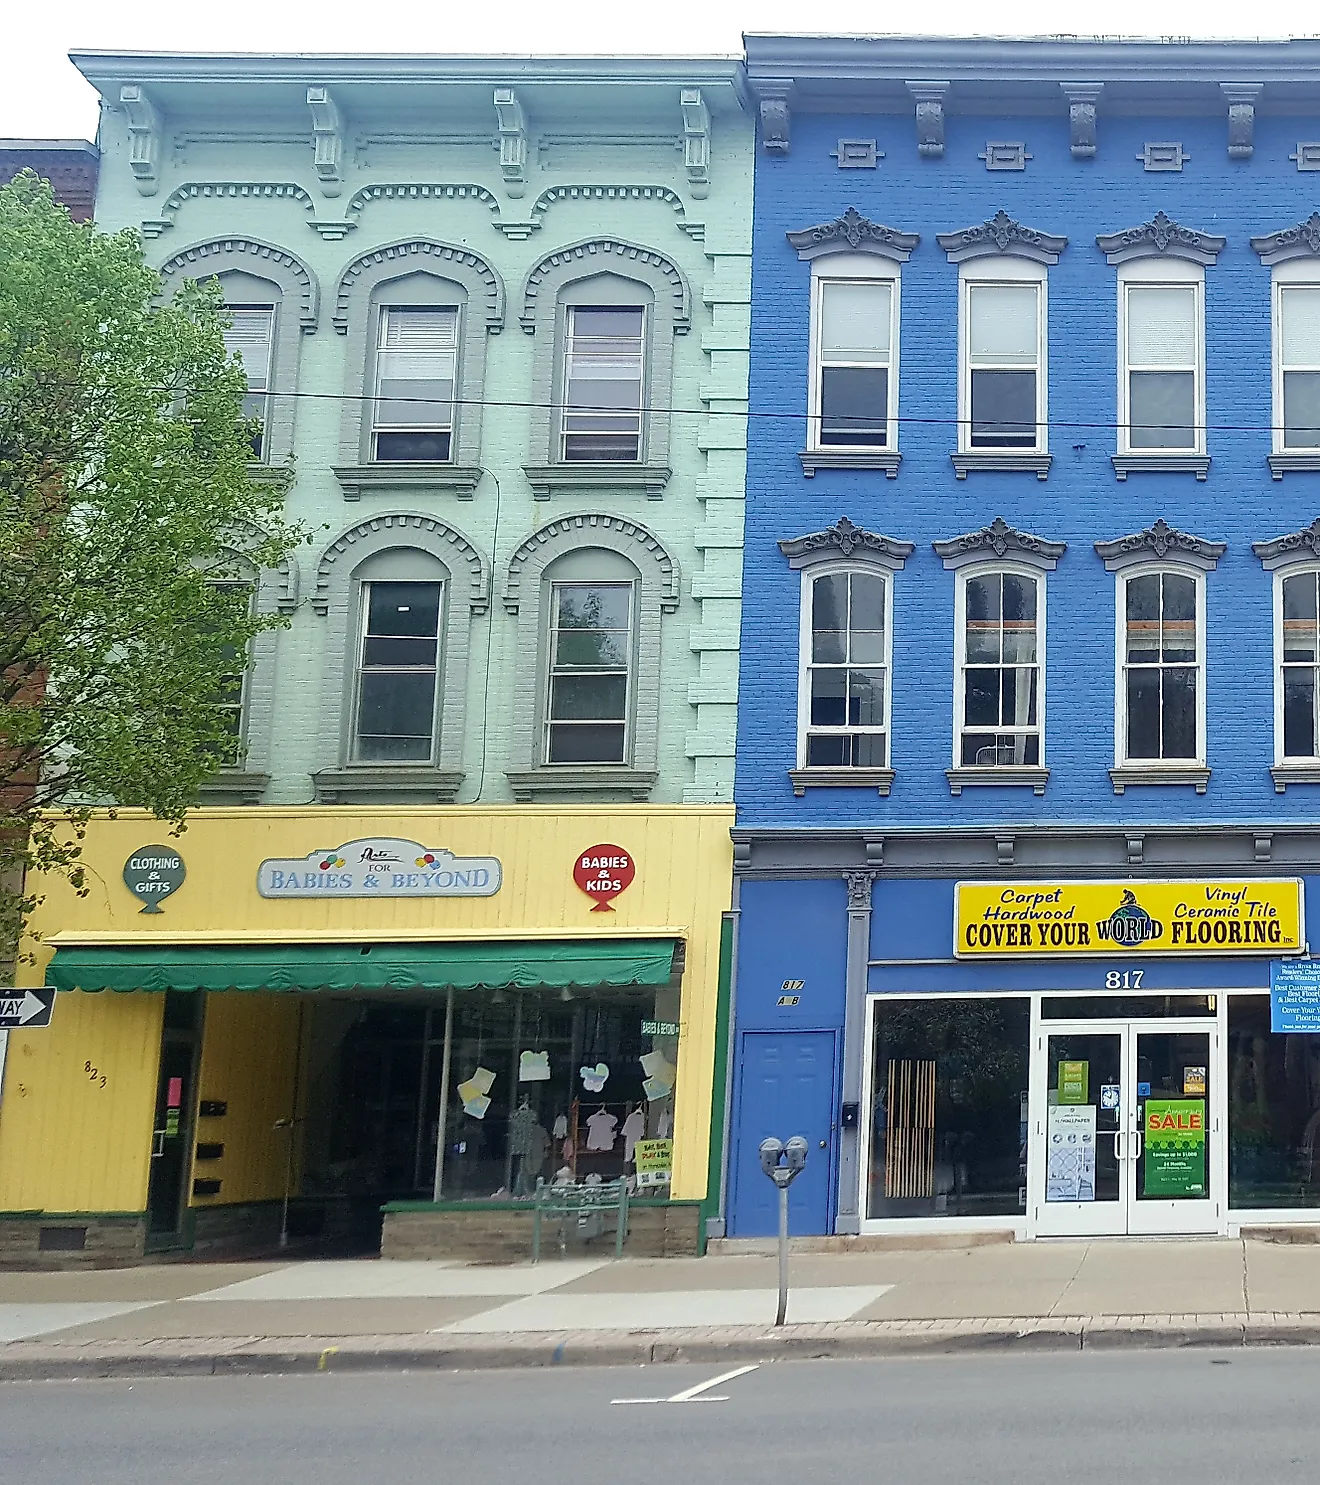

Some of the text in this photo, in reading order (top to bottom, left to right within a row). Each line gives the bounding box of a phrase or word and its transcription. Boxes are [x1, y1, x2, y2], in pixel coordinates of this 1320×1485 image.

[130, 857, 180, 870] CLOTHING
[368, 864, 391, 872] FOR
[581, 856, 628, 869] BABIES
[148, 871, 160, 880] &
[270, 868, 490, 889] BABIES & BEYOND
[597, 870, 610, 879] &
[135, 881, 170, 893] GIFTS
[586, 880, 622, 891] KIDS
[1000, 889, 1063, 909] Carpet
[1205, 886, 1248, 905] Vinyl
[983, 906, 1076, 921] Hardwood
[1174, 901, 1277, 918] Ceramic Tile
[966, 917, 1281, 947] COVER YOUR WORLD FLOORING
[782, 980, 805, 990] 817
[1105, 970, 1145, 989] 817
[778, 996, 799, 1005] A B
[1298, 996, 1318, 1004] Carpet
[84, 1060, 107, 1089] 823
[1148, 1114, 1203, 1130] SALE
